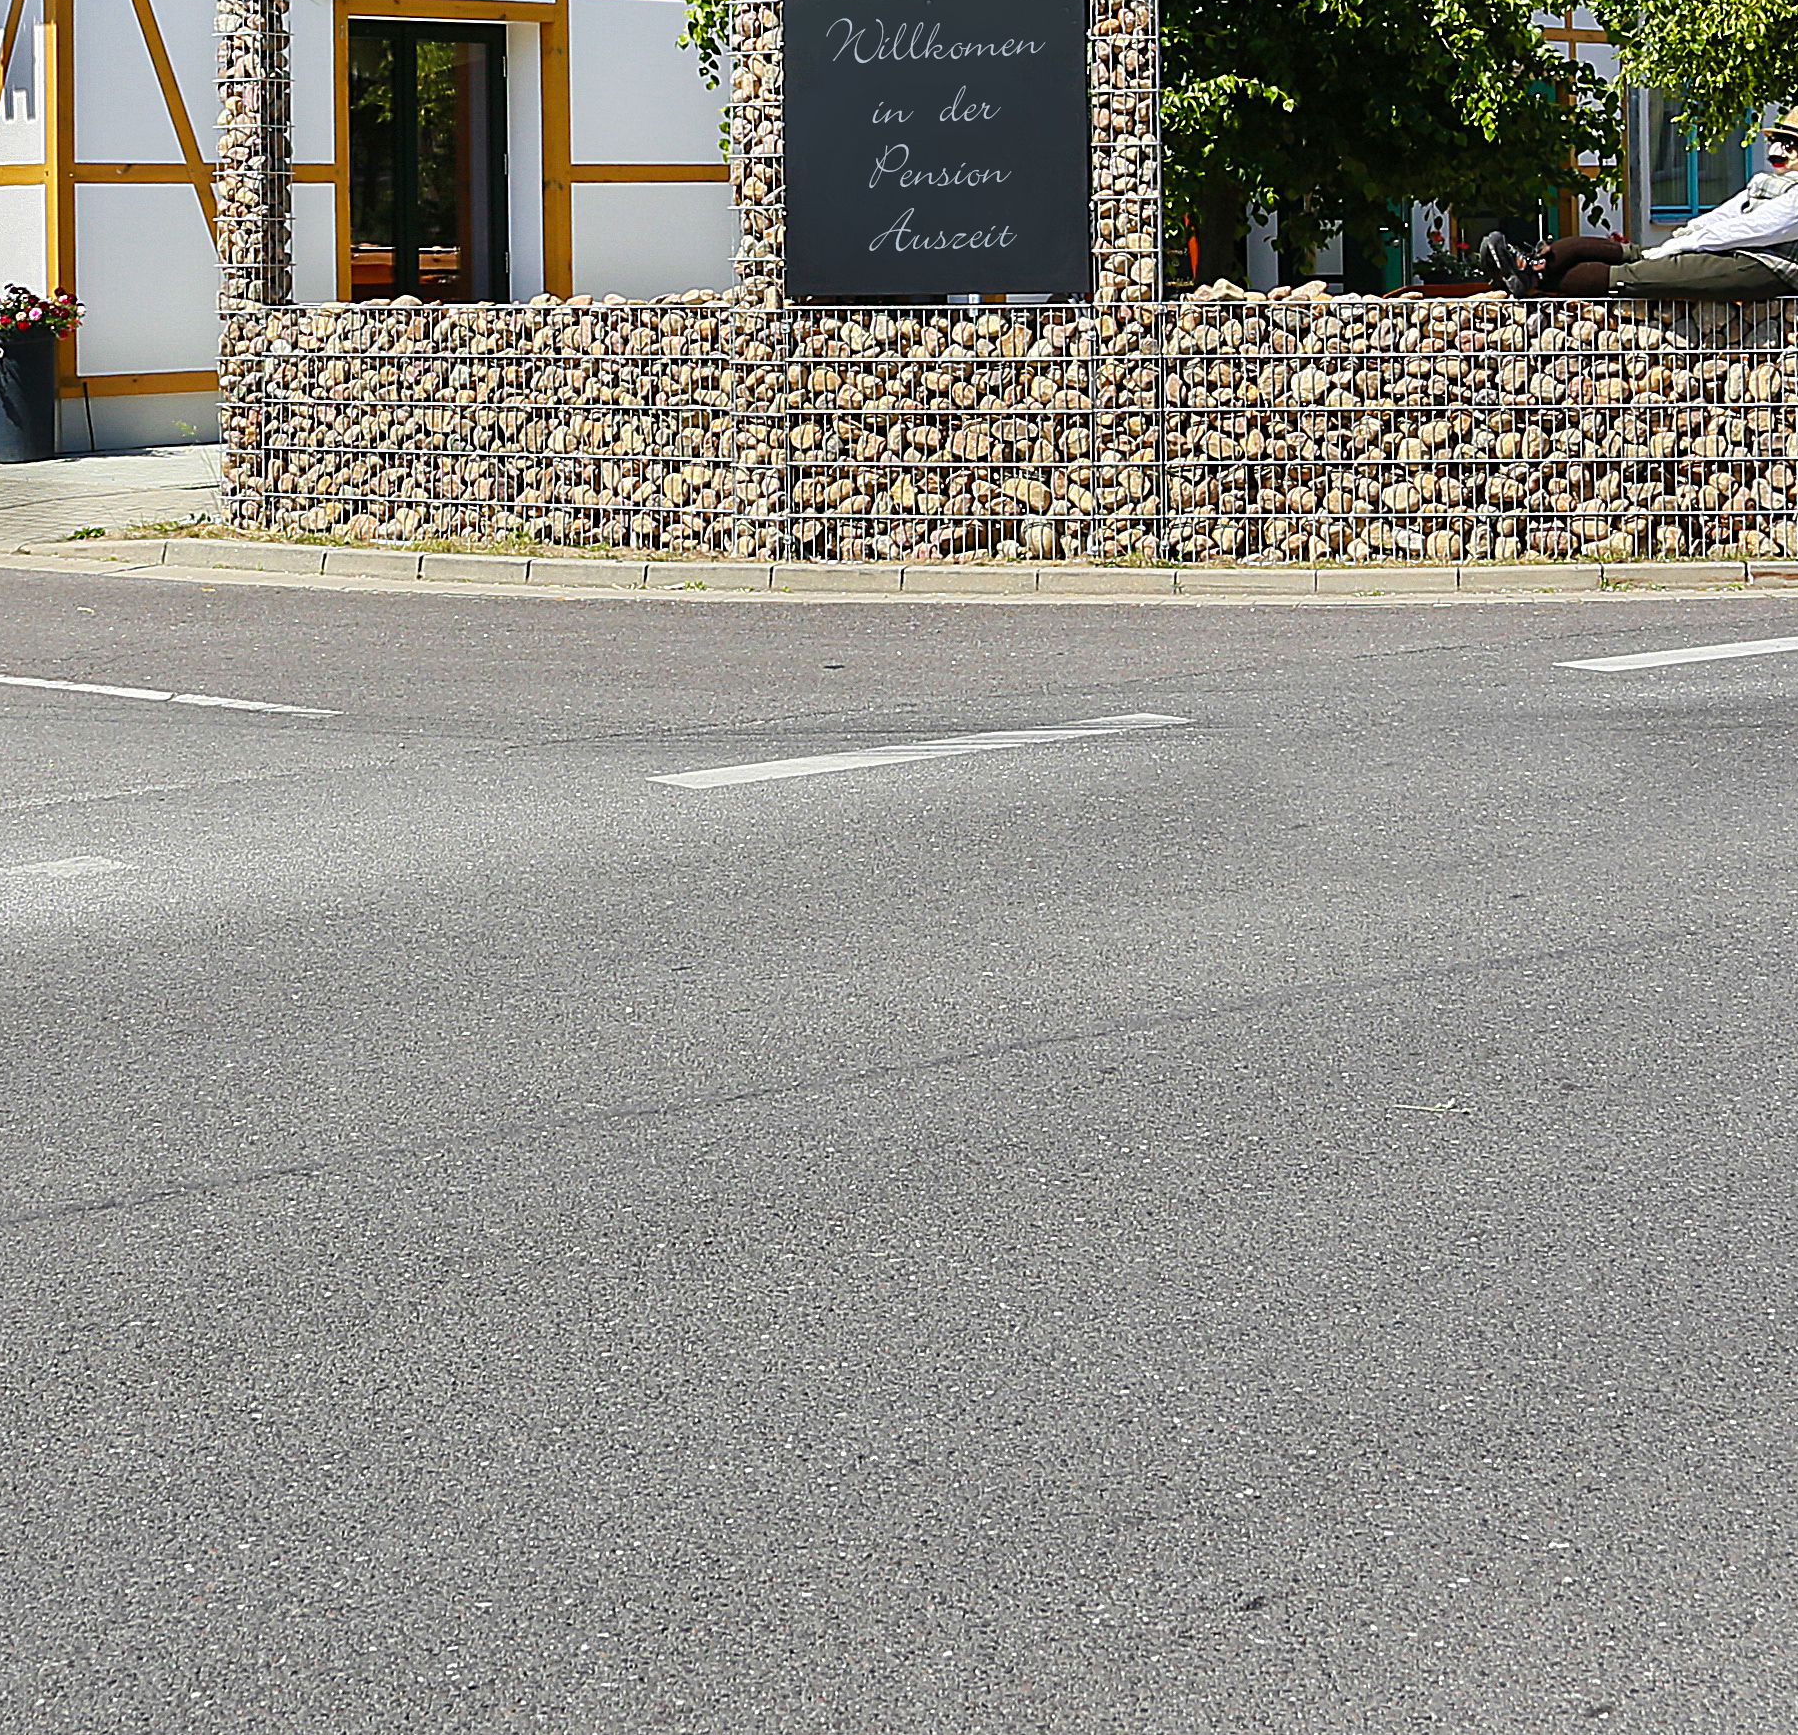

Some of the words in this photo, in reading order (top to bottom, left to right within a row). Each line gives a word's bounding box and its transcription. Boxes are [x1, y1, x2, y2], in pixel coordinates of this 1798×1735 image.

[825, 17, 1046, 64] Willkomen
[871, 101, 915, 124] in
[939, 84, 1002, 123] der
[868, 143, 1012, 189] Pension
[868, 207, 1018, 252] Auszeit
